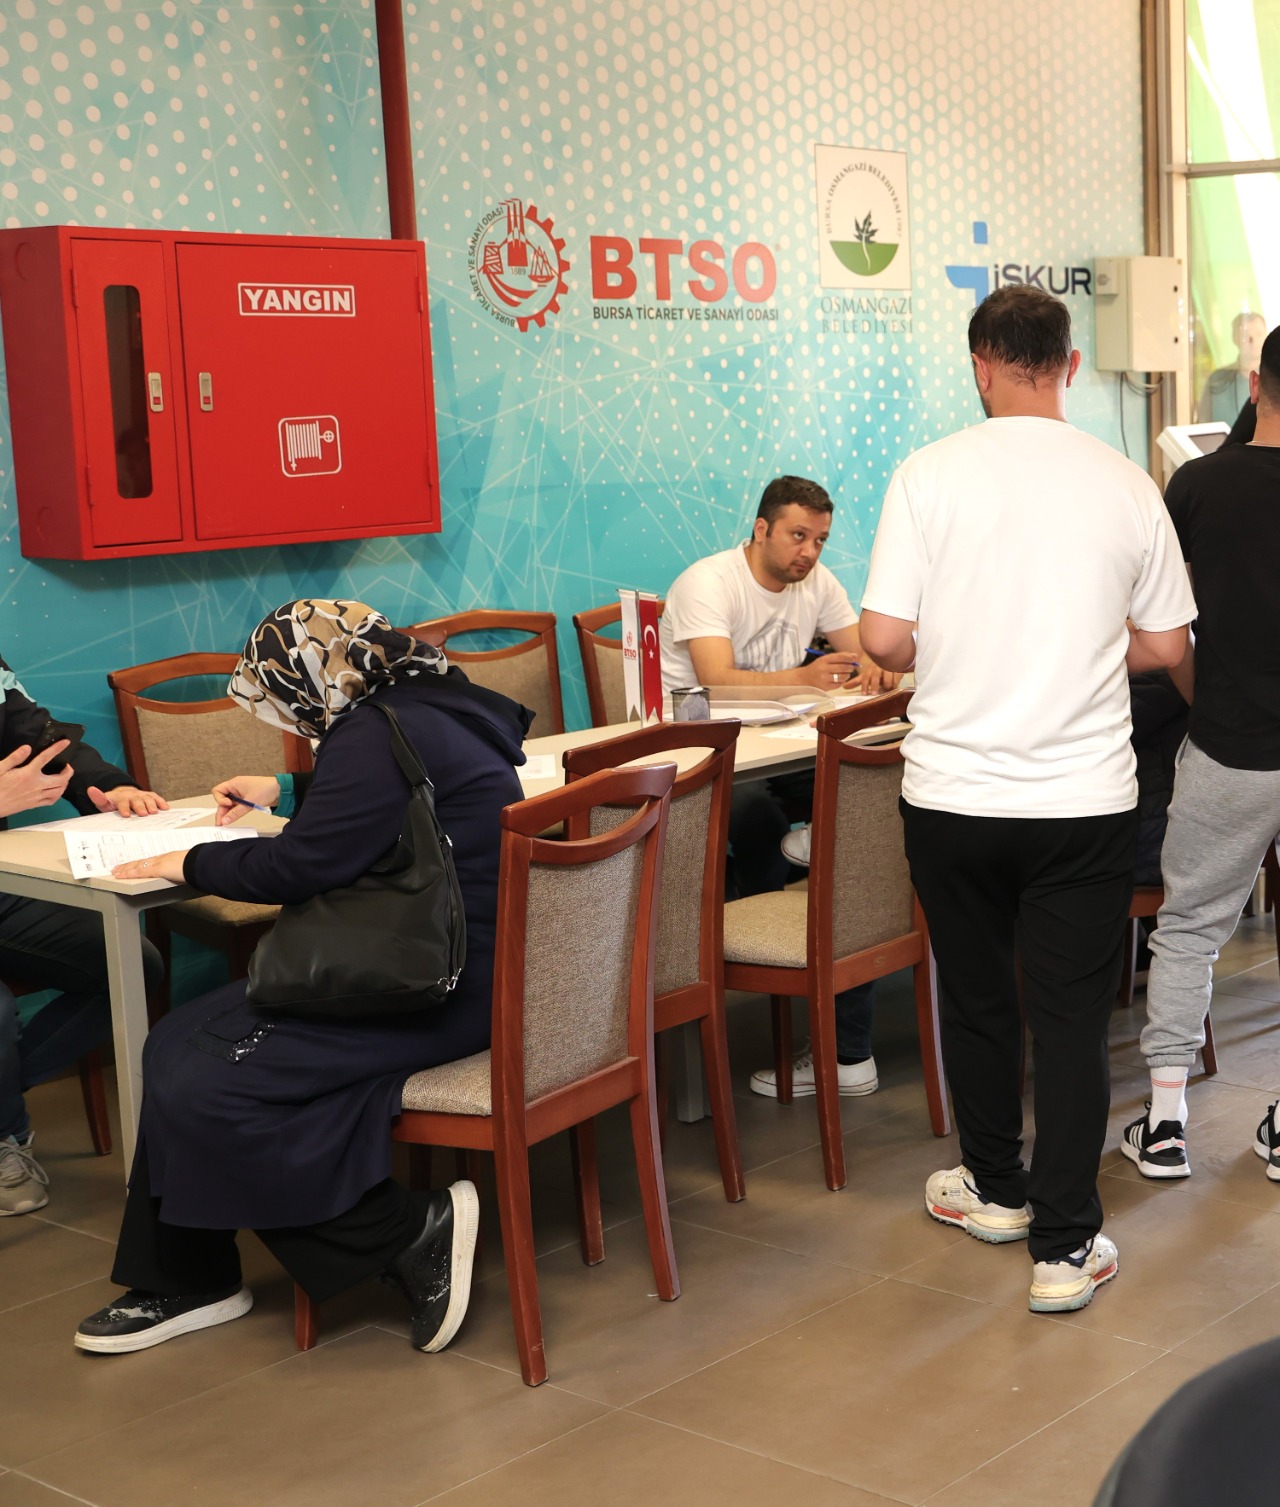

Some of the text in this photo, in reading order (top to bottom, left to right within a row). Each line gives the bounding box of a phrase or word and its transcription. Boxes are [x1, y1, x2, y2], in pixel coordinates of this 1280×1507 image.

[467, 206, 516, 327] BURSA TİCARET VE SANAYİ ODASI
[590, 235, 777, 303] BTSO
[243, 288, 351, 312] YANGIN
[820, 296, 913, 315] OSMANGAZİ
[593, 304, 779, 321] BURSA TİCARET VE SANAYİ ODASI
[822, 319, 913, 334] BELEDİYESİ
